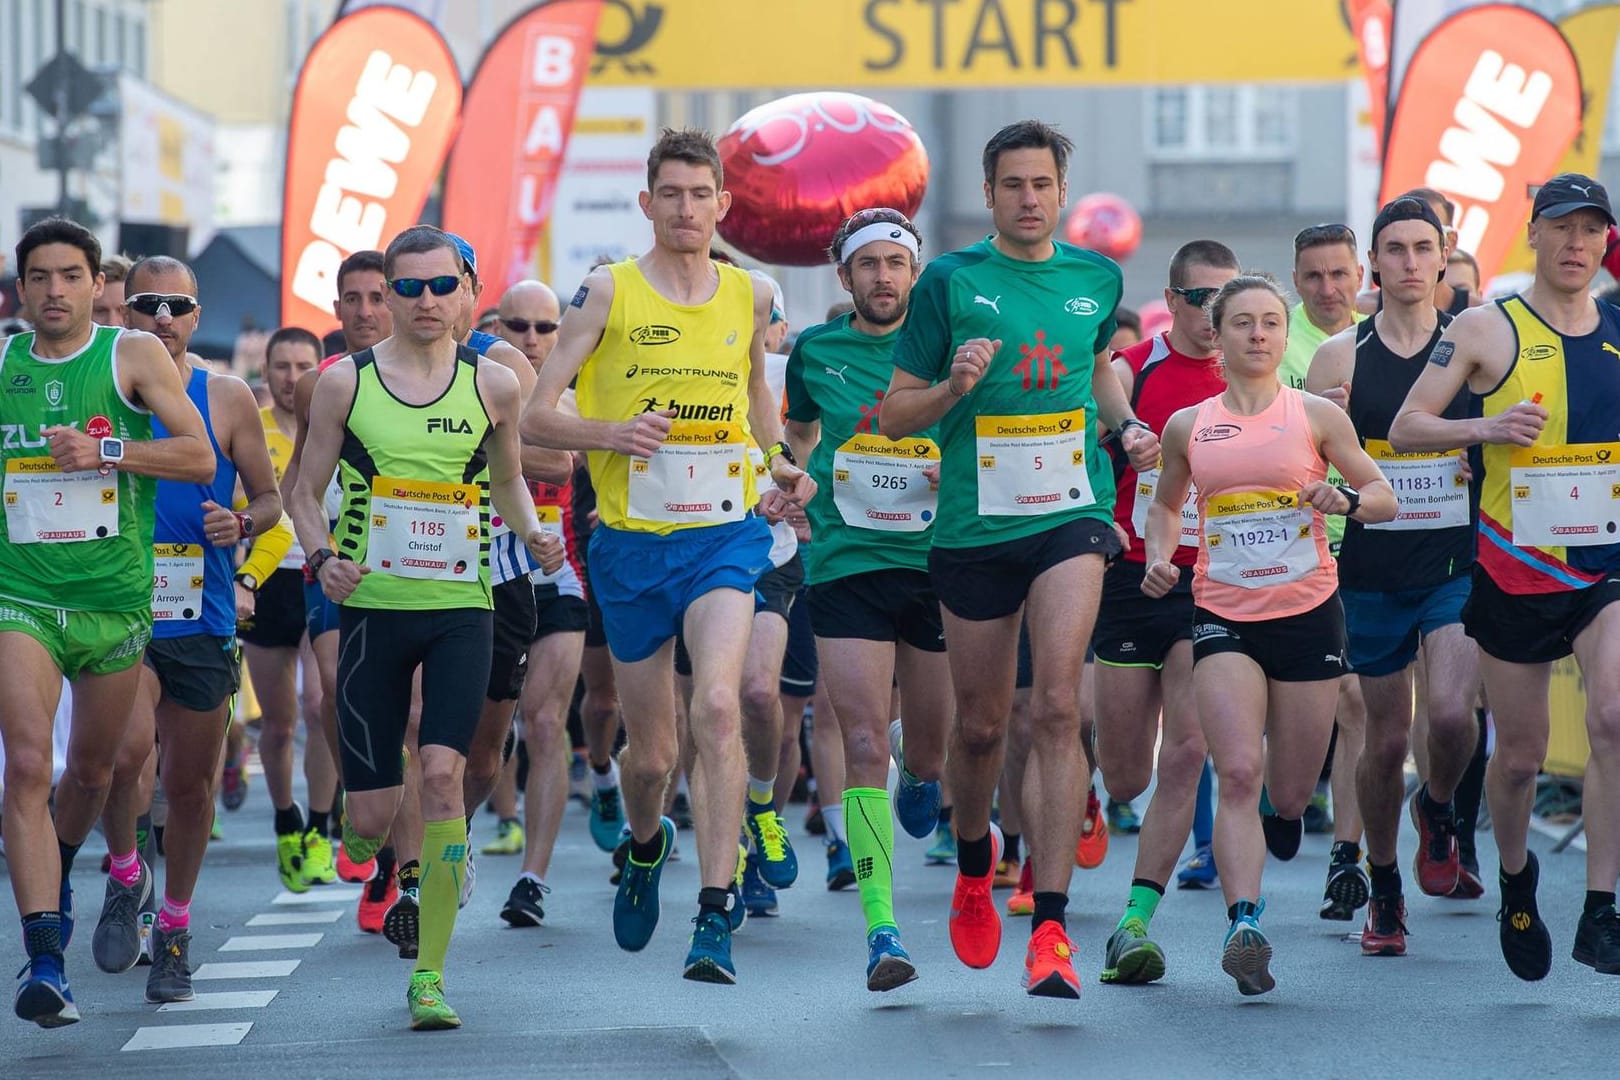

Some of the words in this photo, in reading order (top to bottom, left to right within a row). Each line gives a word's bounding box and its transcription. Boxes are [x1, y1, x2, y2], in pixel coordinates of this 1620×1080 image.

[863, 0, 1134, 70] START
[292, 49, 437, 316] REWE
[641, 367, 738, 380] FRONTRUNNER
[668, 399, 734, 422] bunert
[427, 418, 473, 434] FILA
[997, 426, 1036, 434] Deutsche
[1039, 425, 1056, 433] Post
[694, 434, 711, 442] Post
[854, 443, 891, 454] Deutsche
[893, 447, 910, 455] Post
[1034, 456, 1042, 470] 5
[1532, 456, 1573, 464] Deutsche
[1574, 455, 1593, 463] Post
[19, 462, 56, 470] Deutsche
[688, 465, 694, 479] 1
[872, 474, 908, 490] 9265
[1390, 476, 1443, 490] 11183-1
[54, 492, 63, 506] 2
[432, 492, 450, 501] Post
[1023, 494, 1060, 503] BAUHAUS
[1428, 493, 1464, 503] Bornheim
[1570, 486, 1579, 500] 4
[1218, 503, 1255, 513] Deutsche
[1256, 500, 1275, 508] Post
[873, 512, 910, 520] BAUHAUS
[411, 520, 445, 536] 1185
[1559, 526, 1598, 534] BAUHAUS
[44, 531, 85, 539] BAUHAUS
[1231, 528, 1288, 547] 11922-1
[408, 541, 442, 552] Christof
[408, 559, 446, 568] BAUHAUS
[1248, 566, 1288, 577] BAUHAUS
[156, 594, 185, 604] Arroyo
